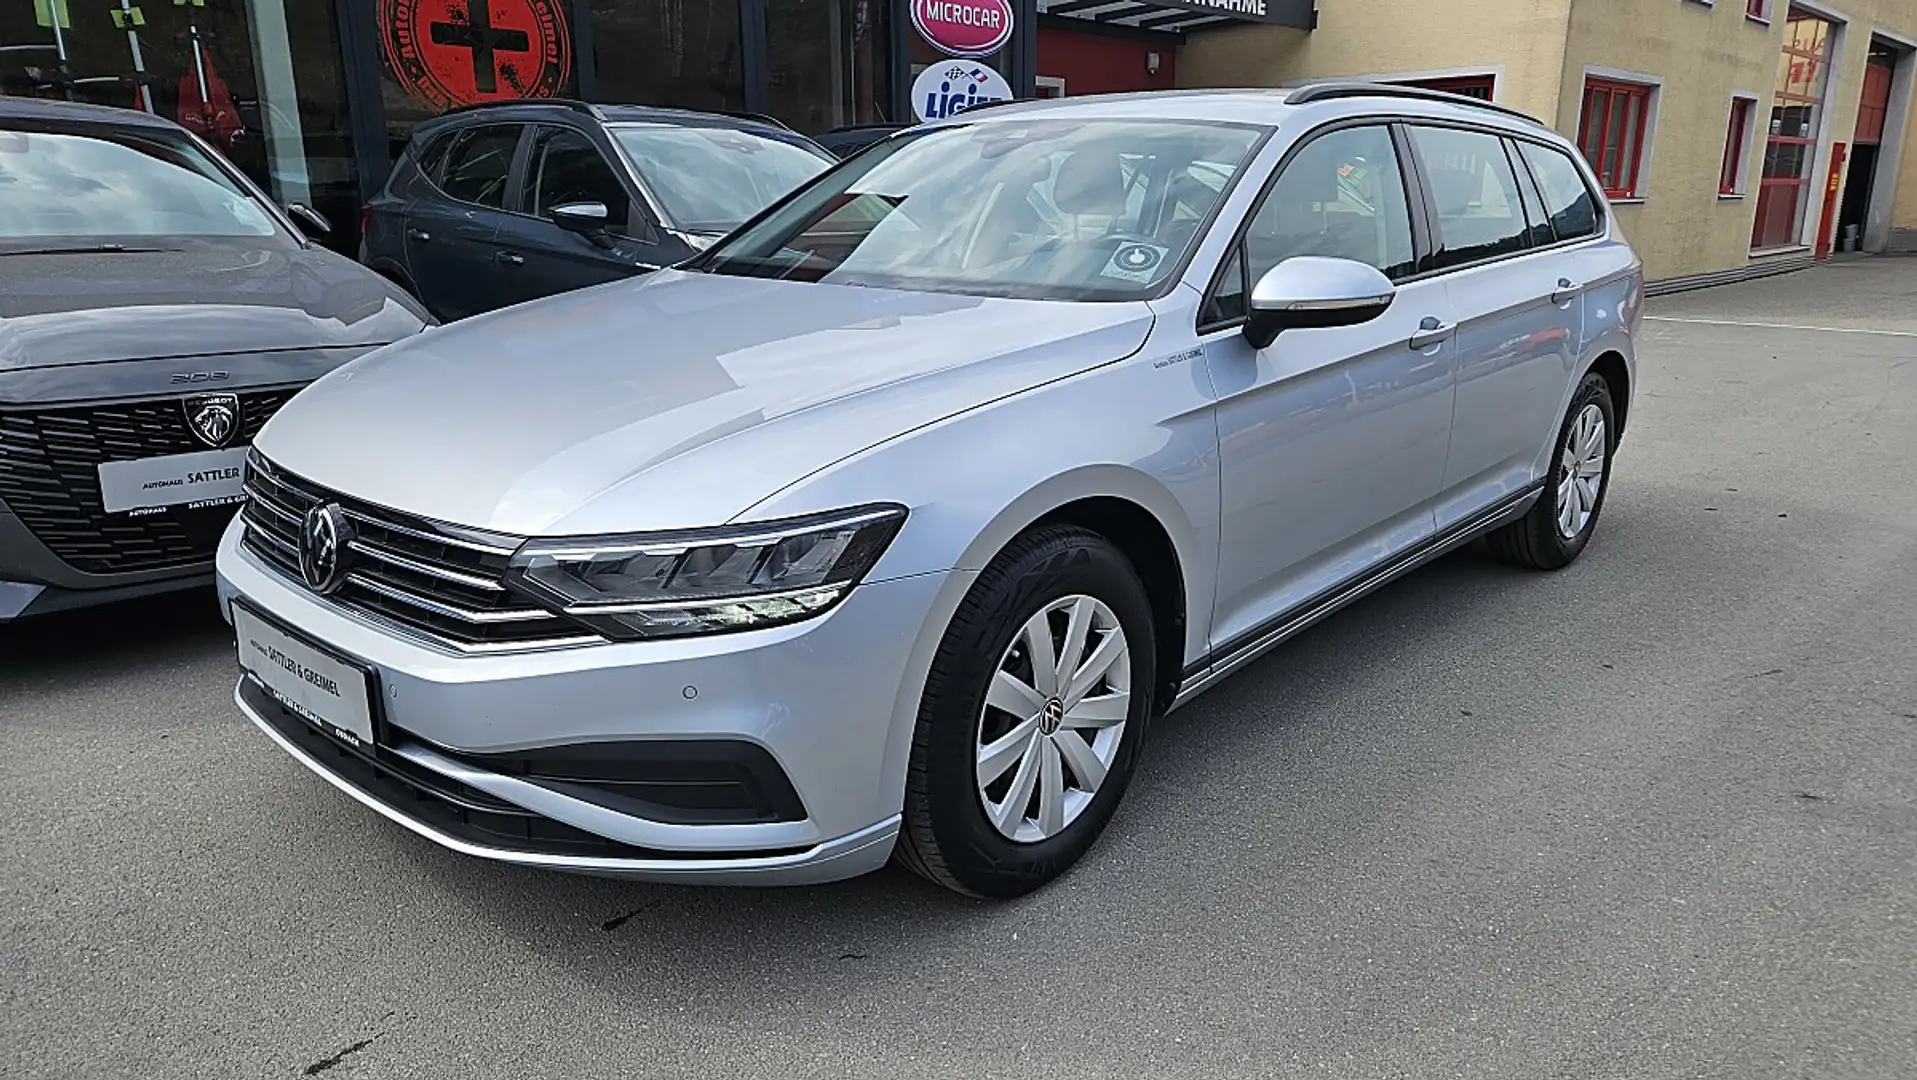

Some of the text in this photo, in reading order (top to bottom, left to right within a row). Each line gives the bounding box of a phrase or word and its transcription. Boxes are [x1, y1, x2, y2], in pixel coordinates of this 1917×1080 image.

[925, 0, 1000, 28] MICROCAR
[395, 0, 416, 58] Auto
[187, 467, 240, 484] SATTLER
